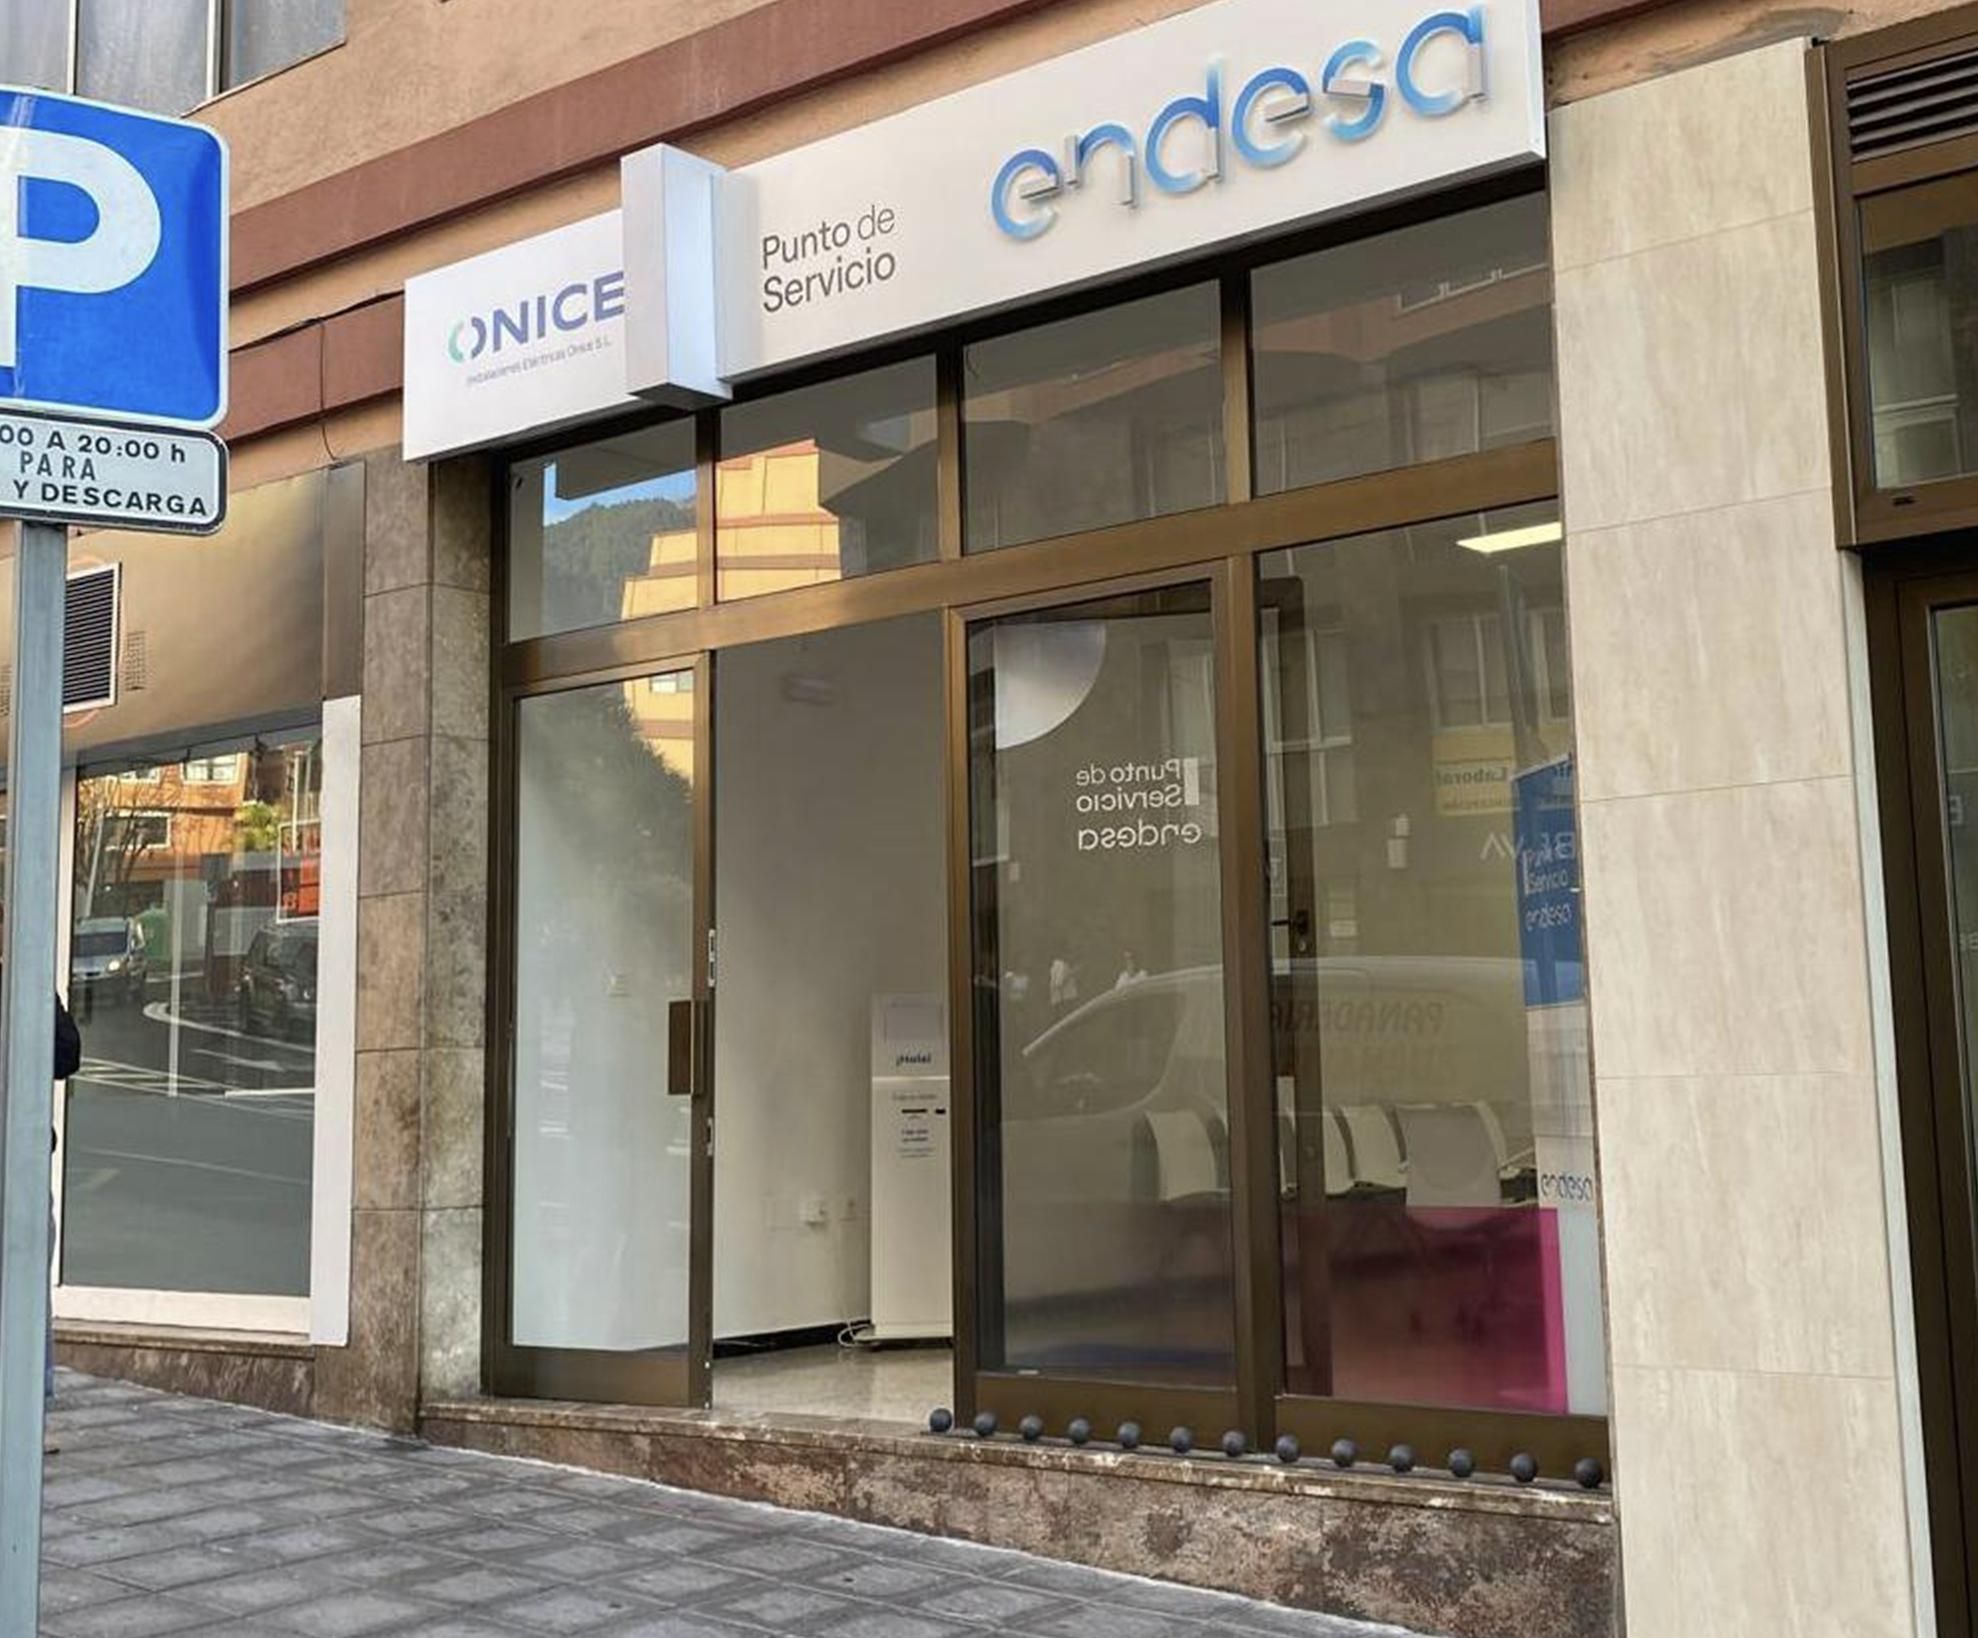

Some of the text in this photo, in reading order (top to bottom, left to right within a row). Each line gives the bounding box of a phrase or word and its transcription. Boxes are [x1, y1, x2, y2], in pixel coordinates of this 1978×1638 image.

[989, 3, 1486, 241] endesa
[0, 124, 162, 368] P
[762, 204, 895, 270] Punto de
[763, 246, 896, 313] Servicio
[448, 270, 625, 363] ONICE
[20, 451, 96, 481] PARA
[47, 431, 66, 450] A
[77, 434, 159, 460] 20:00
[171, 443, 186, 463] h
[13, 479, 208, 516] Y DESCARGA
